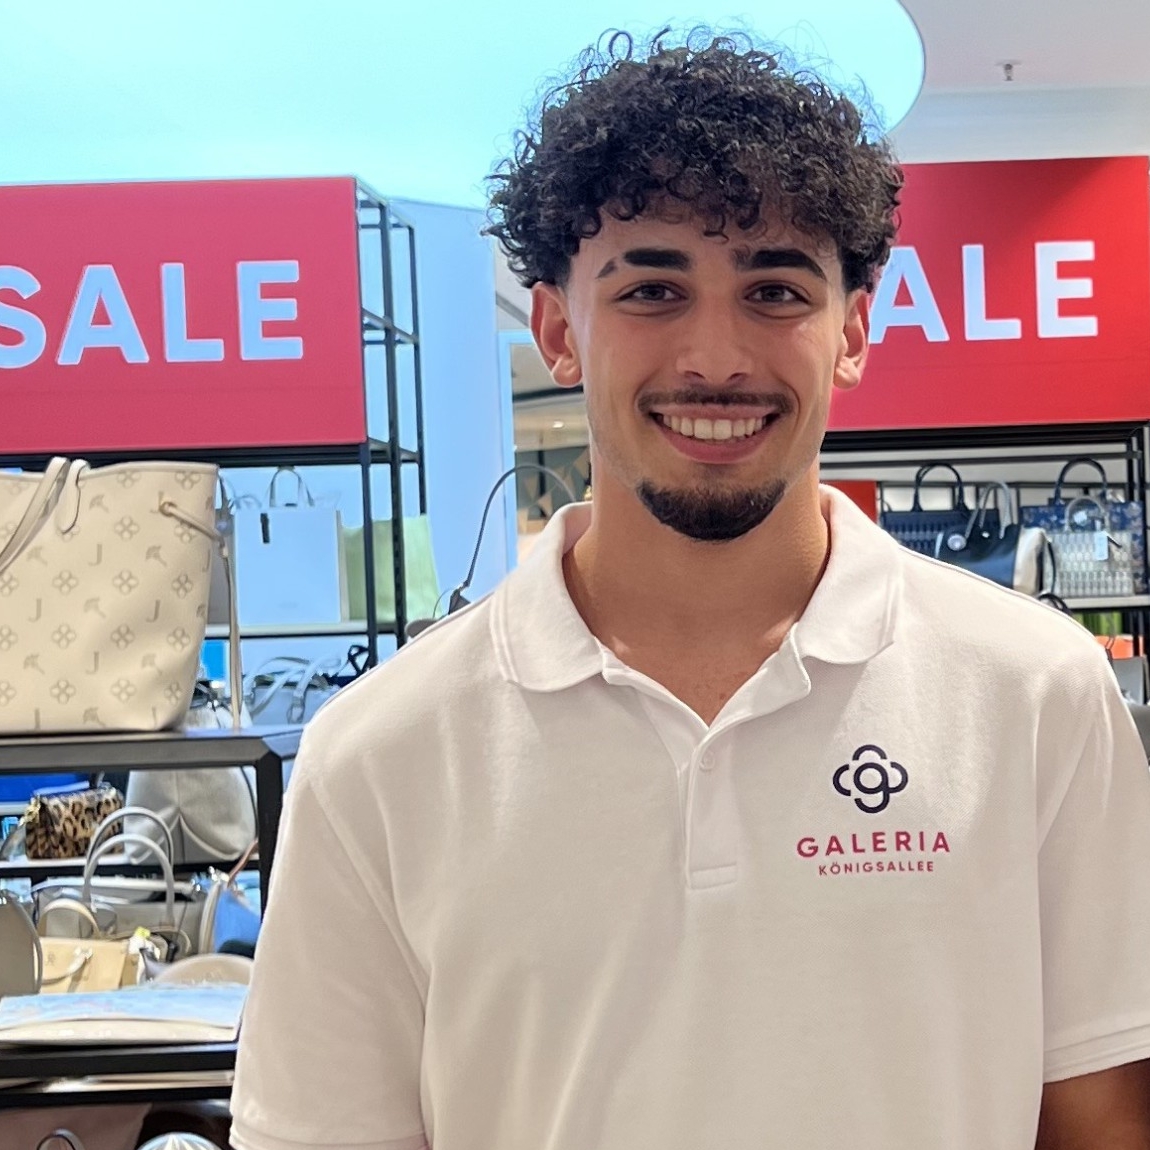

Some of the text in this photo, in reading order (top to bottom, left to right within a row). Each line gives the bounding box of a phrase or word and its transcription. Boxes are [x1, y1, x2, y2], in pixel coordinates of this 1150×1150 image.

[0, 260, 304, 369] SALE
[869, 240, 1098, 345] ALE
[796, 831, 950, 858] GALERIA
[818, 861, 934, 876] KÖNIGSALLEE
